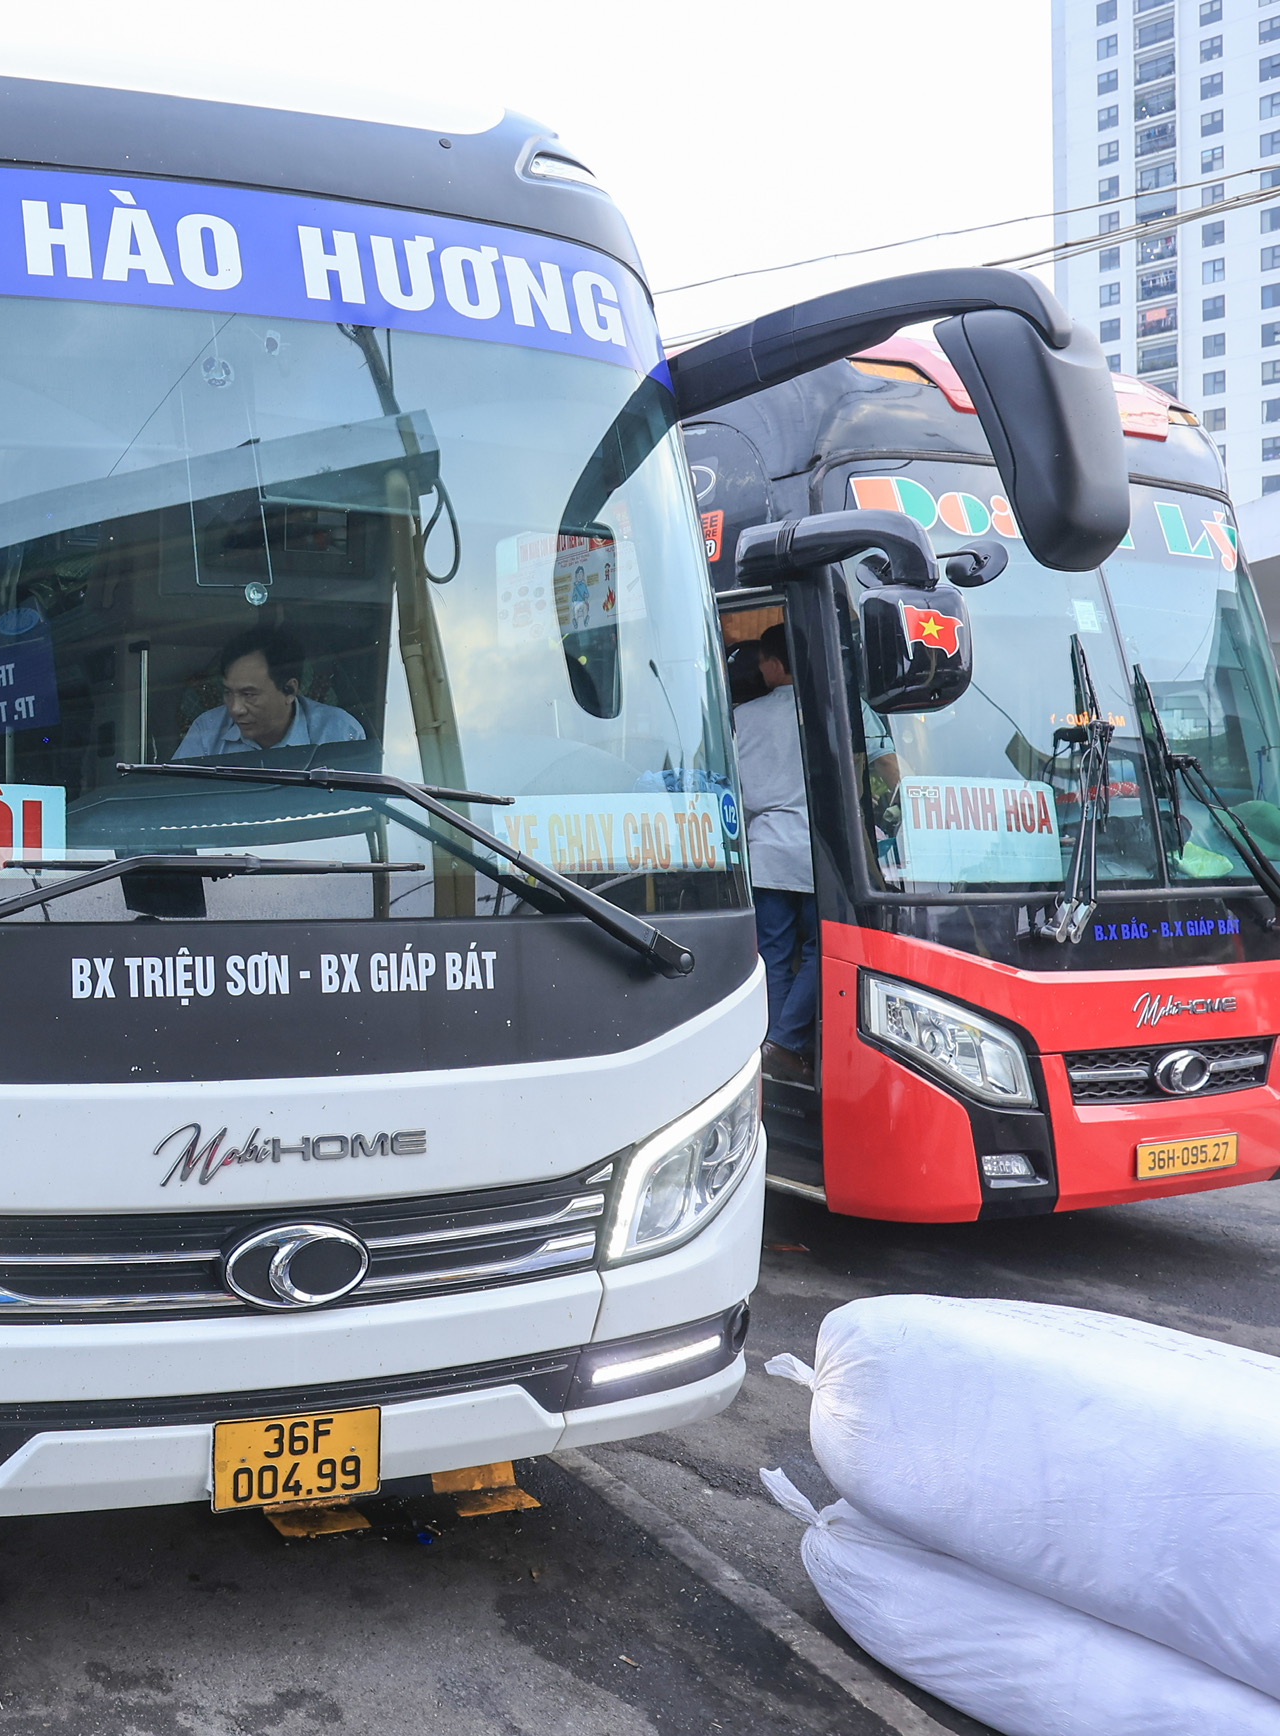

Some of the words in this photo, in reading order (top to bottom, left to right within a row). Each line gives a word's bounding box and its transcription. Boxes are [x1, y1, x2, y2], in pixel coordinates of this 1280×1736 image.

[22, 189, 242, 290] HÀO
[297, 225, 627, 347] HƯƠNG
[623, 812, 671, 870] CAO
[674, 793, 716, 870] TỐC
[906, 786, 998, 831] THANH
[1003, 781, 1053, 834] HÓA
[1094, 924, 1118, 941] B.X
[1161, 920, 1183, 938] B.X
[1186, 916, 1215, 936] GIÁP
[71, 957, 116, 999] BX
[124, 946, 216, 1006] TRIỆU
[225, 951, 290, 996] SƠN
[320, 954, 361, 993] BX
[370, 943, 436, 992] GIÁP
[445, 941, 497, 991] BÁT
[1148, 1141, 1229, 1171] 36H-095.27
[263, 1417, 334, 1459] 36F
[233, 1455, 361, 1503] 004.99
